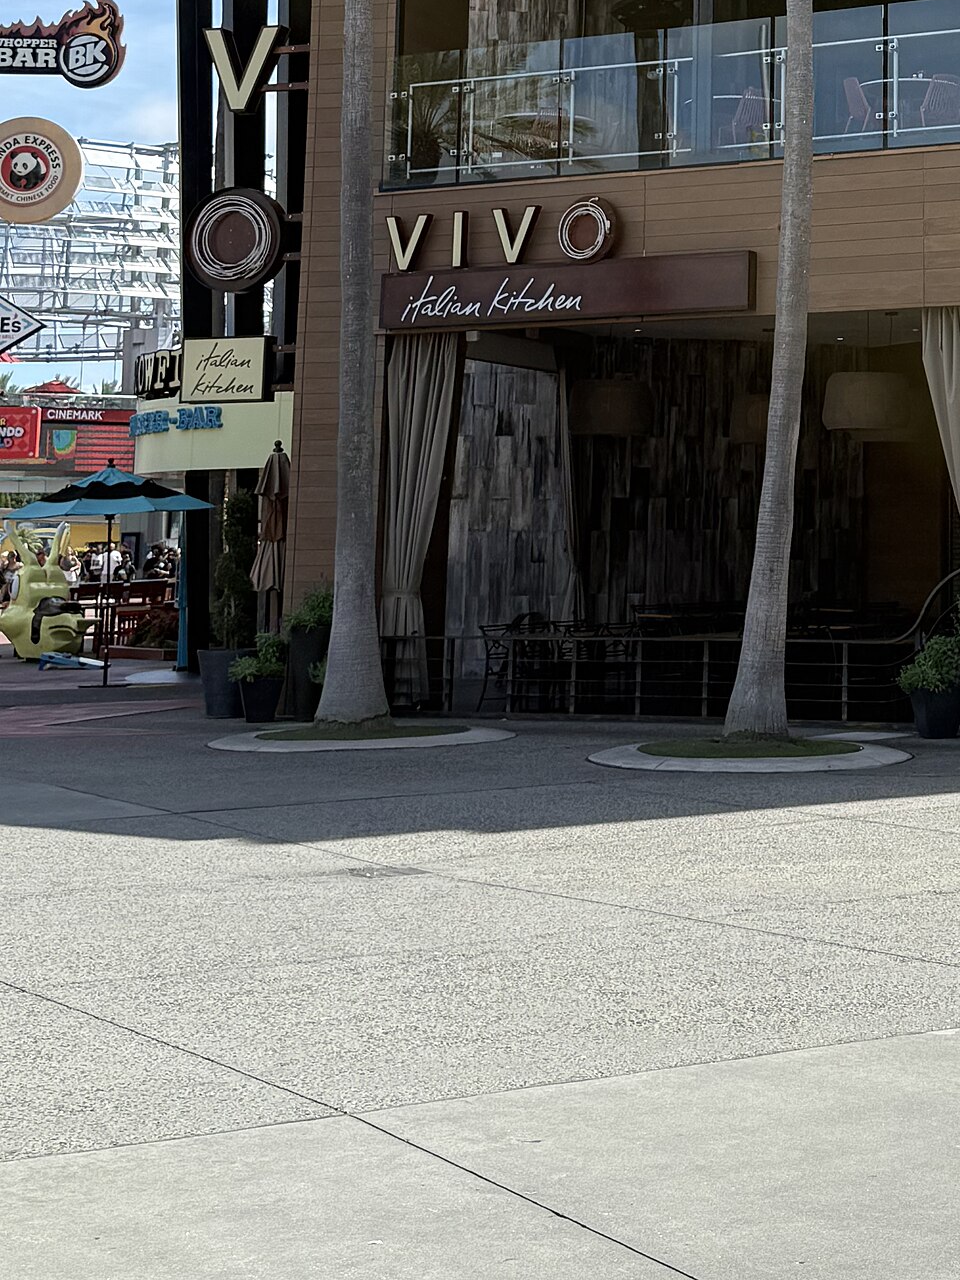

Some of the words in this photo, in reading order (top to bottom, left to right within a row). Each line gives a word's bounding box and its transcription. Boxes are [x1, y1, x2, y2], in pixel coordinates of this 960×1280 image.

[0, 47, 57, 68] BAR
[68, 40, 108, 70] BK
[0, 137, 21, 160] NDA
[24, 135, 61, 169] EXPRESS
[386, 195, 612, 272] VIVO
[135, 350, 182, 393] OWFI
[195, 342, 252, 372] italian
[46, 409, 103, 420] CINEMARK
